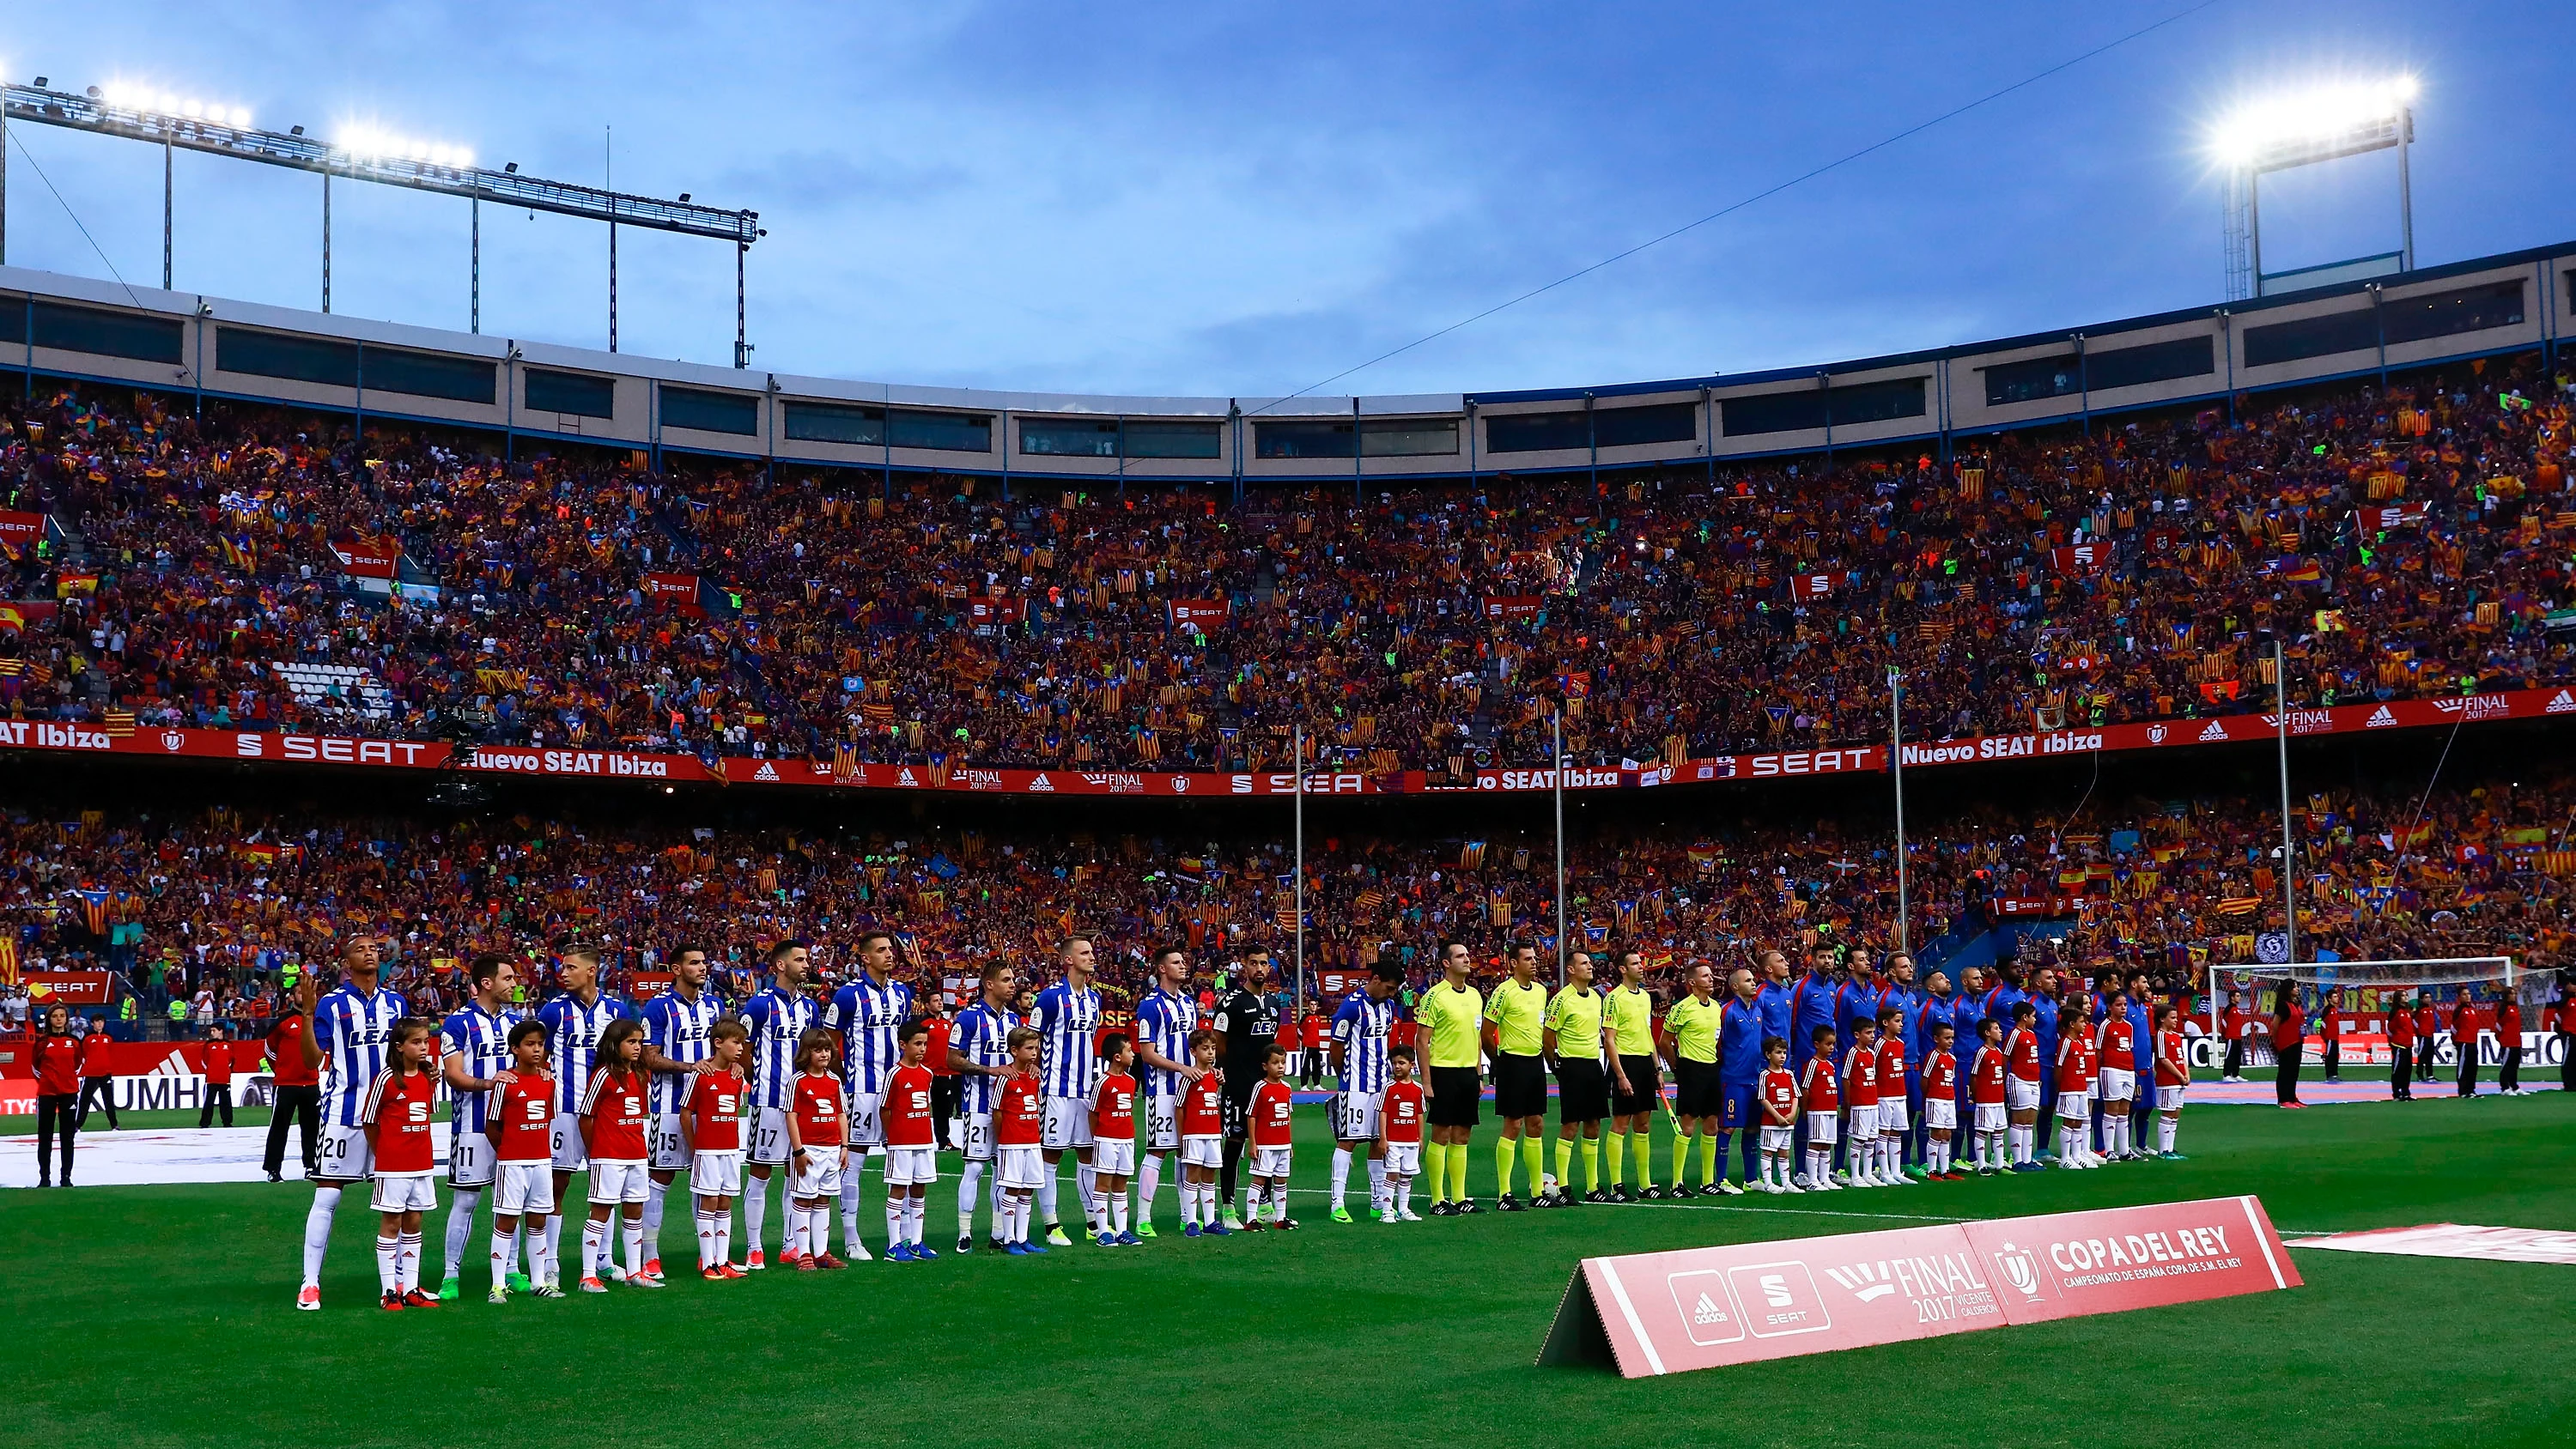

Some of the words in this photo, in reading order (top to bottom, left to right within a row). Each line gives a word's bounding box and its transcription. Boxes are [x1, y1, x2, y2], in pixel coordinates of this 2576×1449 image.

[355, 556, 389, 565] SEAT
[2465, 695, 2509, 710] FINAL
[2546, 703, 2576, 712] adida
[2292, 711, 2333, 725] FINAL
[2466, 710, 2489, 719] 2017
[2293, 724, 2314, 733] 2017
[2366, 718, 2397, 727] adidas
[38, 723, 111, 749] Ibiza
[2199, 732, 2228, 741] adidas
[283, 737, 424, 764] SEAT
[1902, 745, 1974, 766] Nuevo
[1979, 736, 2036, 759] SEAT
[2043, 731, 2103, 754] Ibiza
[544, 751, 603, 773] SEAT
[609, 755, 667, 777] Ibiza
[1753, 749, 1870, 776] SEAT
[754, 773, 780, 781] adidas
[969, 771, 1001, 783] FINAL
[1109, 773, 1143, 785] FINAL
[1502, 771, 1556, 790] SEAT
[1563, 769, 1618, 788] Ibiza
[39, 983, 98, 991] SEAT
[637, 981, 672, 990] SEA
[867, 1012, 903, 1028] LEA
[1066, 1018, 1096, 1033] LEA
[1170, 1020, 1195, 1034] LEA
[1250, 1022, 1278, 1035] LEA
[1363, 1025, 1392, 1039] LEA
[1235, 1106, 1240, 1121] 1
[1728, 1100, 1735, 1113] 8
[853, 1112, 872, 1130] 24
[1349, 1107, 1364, 1125] 19
[1048, 1117, 1057, 1134] 2
[1156, 1117, 1172, 1133] 22
[553, 1131, 562, 1150] 6
[660, 1133, 677, 1151] 15
[760, 1129, 778, 1148] 17
[971, 1125, 987, 1144] 21
[323, 1137, 346, 1160] 20
[459, 1147, 473, 1167] 11
[2050, 1240, 2132, 1272] COPA
[2127, 1232, 2184, 1264] DEL
[2177, 1226, 2231, 1258] REY
[1891, 1252, 1986, 1297] FINAL
[2063, 1275, 2121, 1288] CAMPEONATO
[2123, 1271, 2135, 1281] DE
[2136, 1265, 2166, 1279] ESPAÑA
[2166, 1265, 2189, 1276] COPA
[2189, 1264, 2200, 1273] DE
[2201, 1260, 2218, 1271] S.M.
[2218, 1259, 2228, 1269] EL
[2227, 1258, 2242, 1267] REY
[1953, 1291, 1993, 1306] VICENTE
[1912, 1294, 1956, 1323] 2017
[1961, 1304, 1999, 1317] CALDERÓN
[1694, 1312, 1728, 1325] adidas
[1766, 1311, 1807, 1325] SEAT
